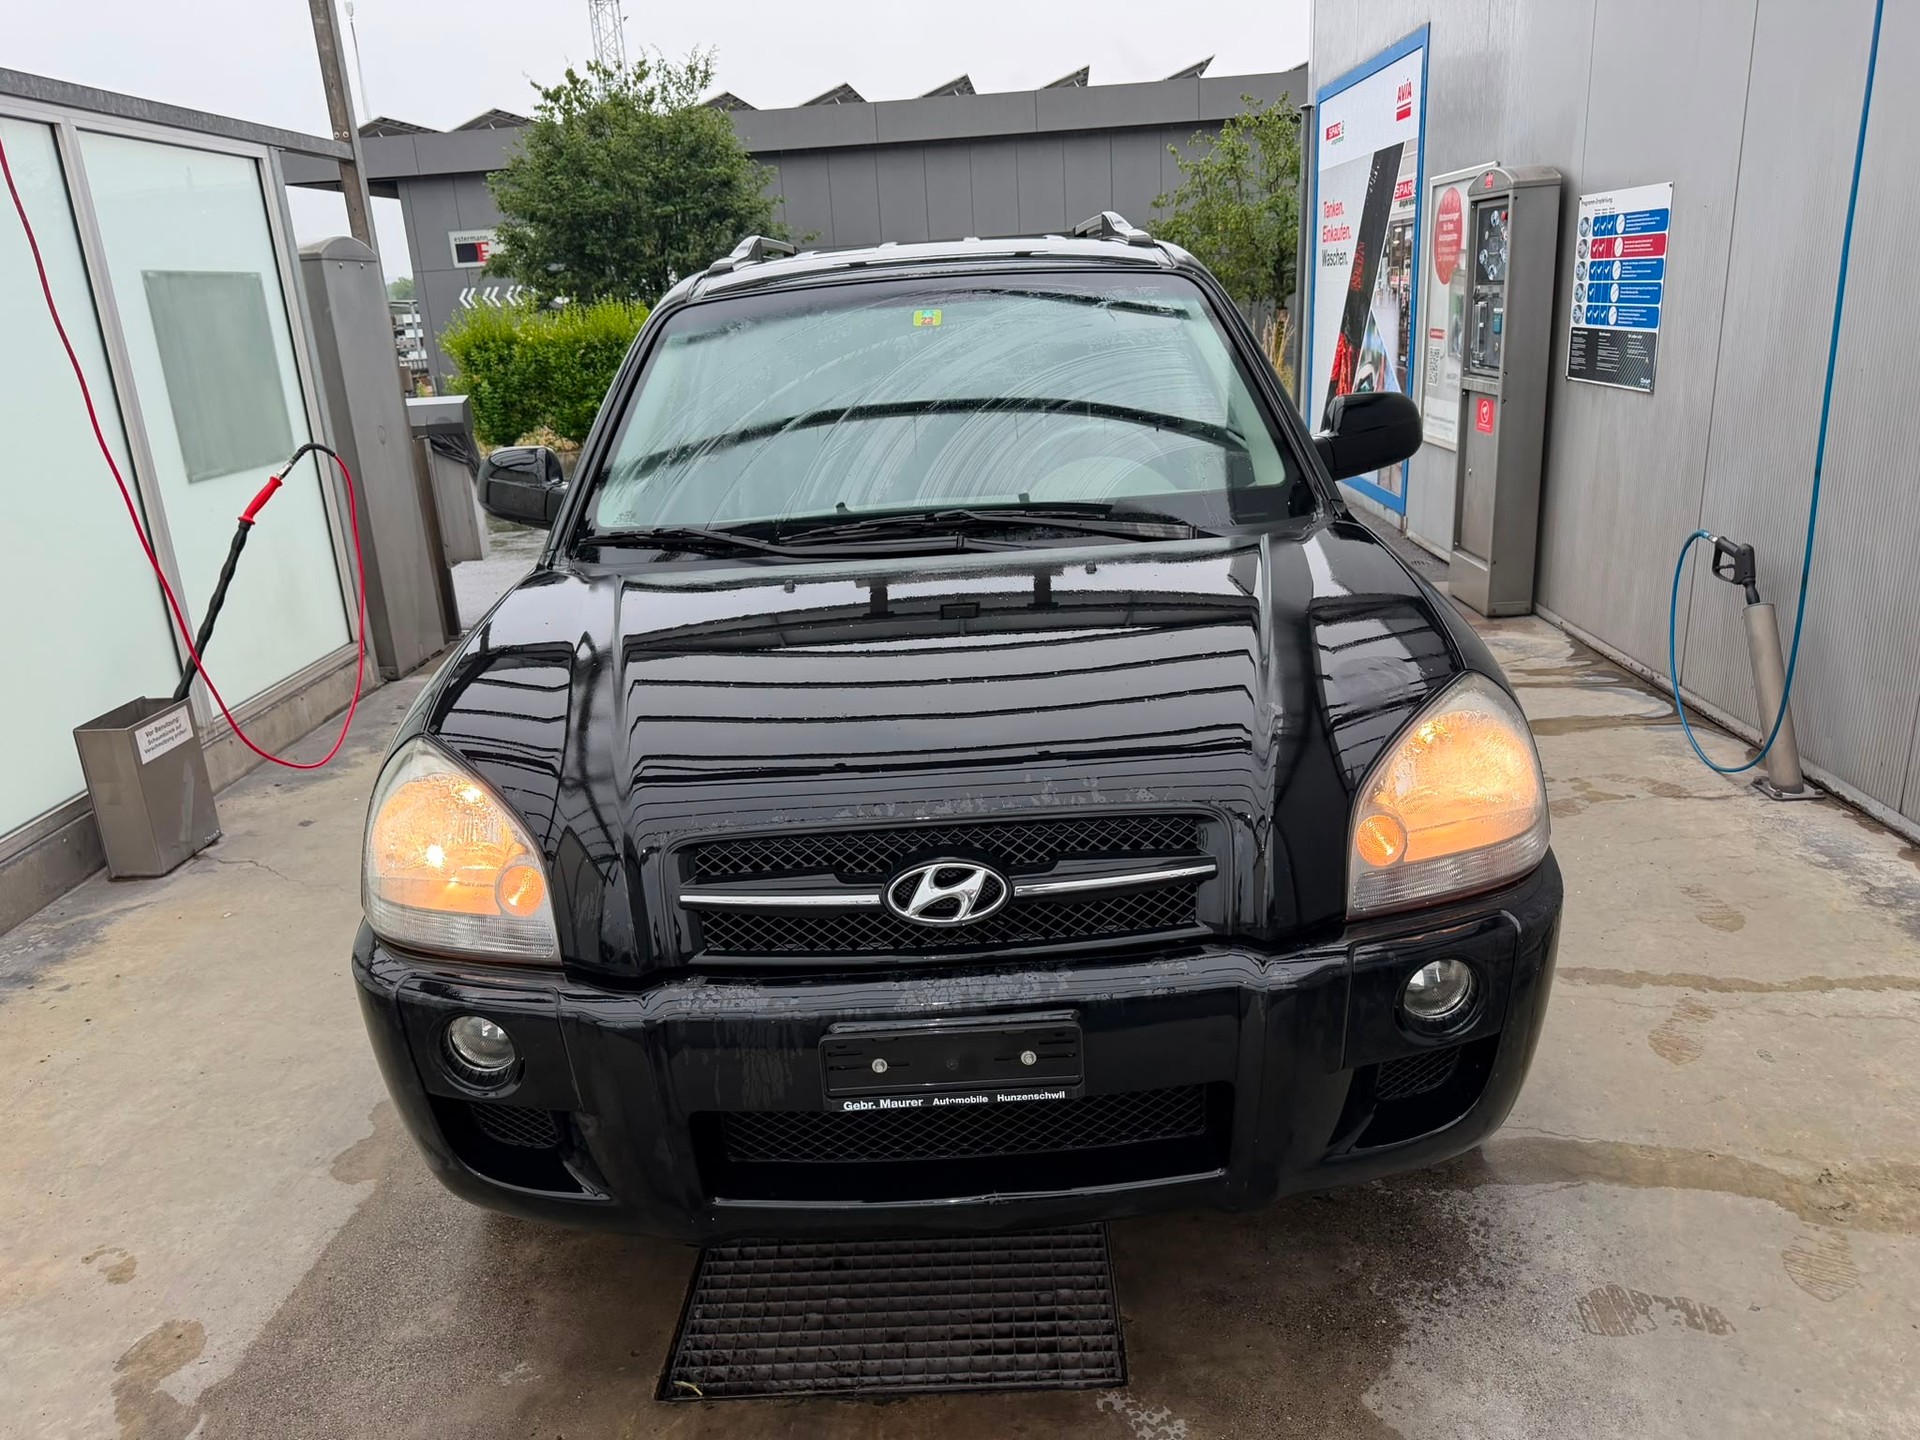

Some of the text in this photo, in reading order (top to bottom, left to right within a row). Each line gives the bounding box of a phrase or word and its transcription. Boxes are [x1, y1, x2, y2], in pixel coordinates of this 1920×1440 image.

[1397, 82, 1412, 104] AVIA
[1327, 123, 1341, 139] SPAR
[1395, 181, 1413, 198] SPAR
[1323, 200, 1345, 219] Tanken.
[1322, 223, 1352, 243] Einkaufen.
[1321, 249, 1348, 266] Waschen.
[843, 1091, 1065, 1111] Gebr. Maurer Automobile Hunzenschwil
